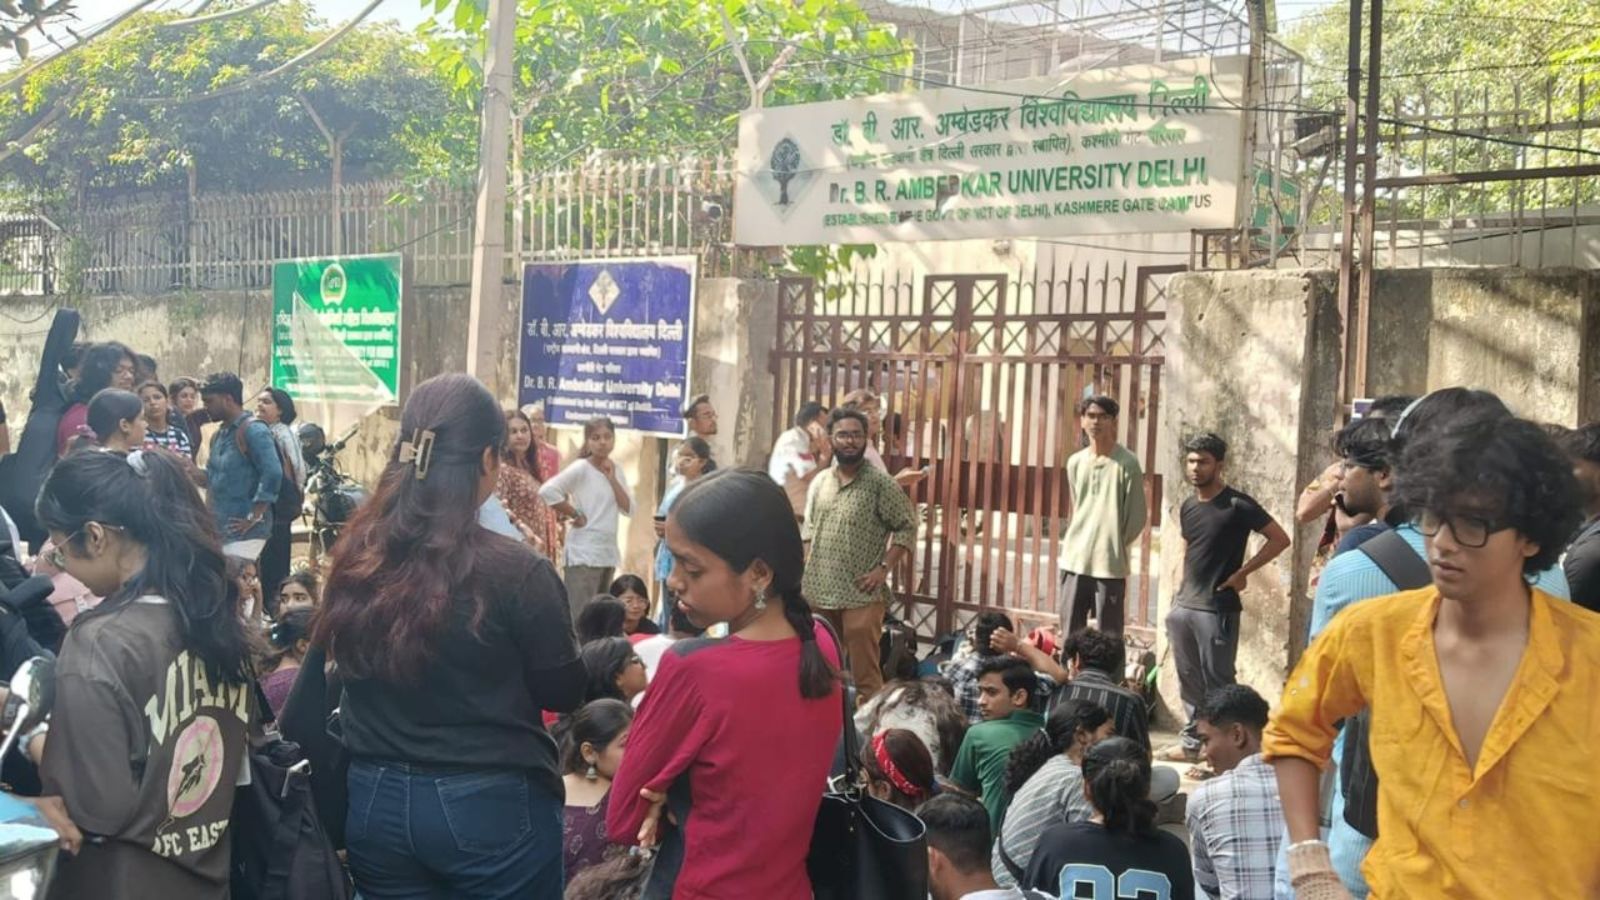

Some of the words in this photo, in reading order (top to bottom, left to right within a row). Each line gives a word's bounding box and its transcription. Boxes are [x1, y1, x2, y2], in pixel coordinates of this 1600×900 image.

[890, 116, 924, 141] आर.
[935, 106, 1011, 137] अम्बेडकर
[969, 143, 1001, 158] सरकार
[874, 179, 891, 202] R.
[1008, 161, 1133, 195] UNIVERSITY
[1138, 157, 1209, 187] DELHI
[1054, 198, 1120, 216] KASHMERE
[1123, 197, 1154, 213] GATE
[524, 375, 535, 389] Dr.
[559, 377, 604, 393] Ambedkar
[605, 379, 653, 399] University
[655, 380, 681, 398] Delhi
[187, 820, 229, 852] EAST
